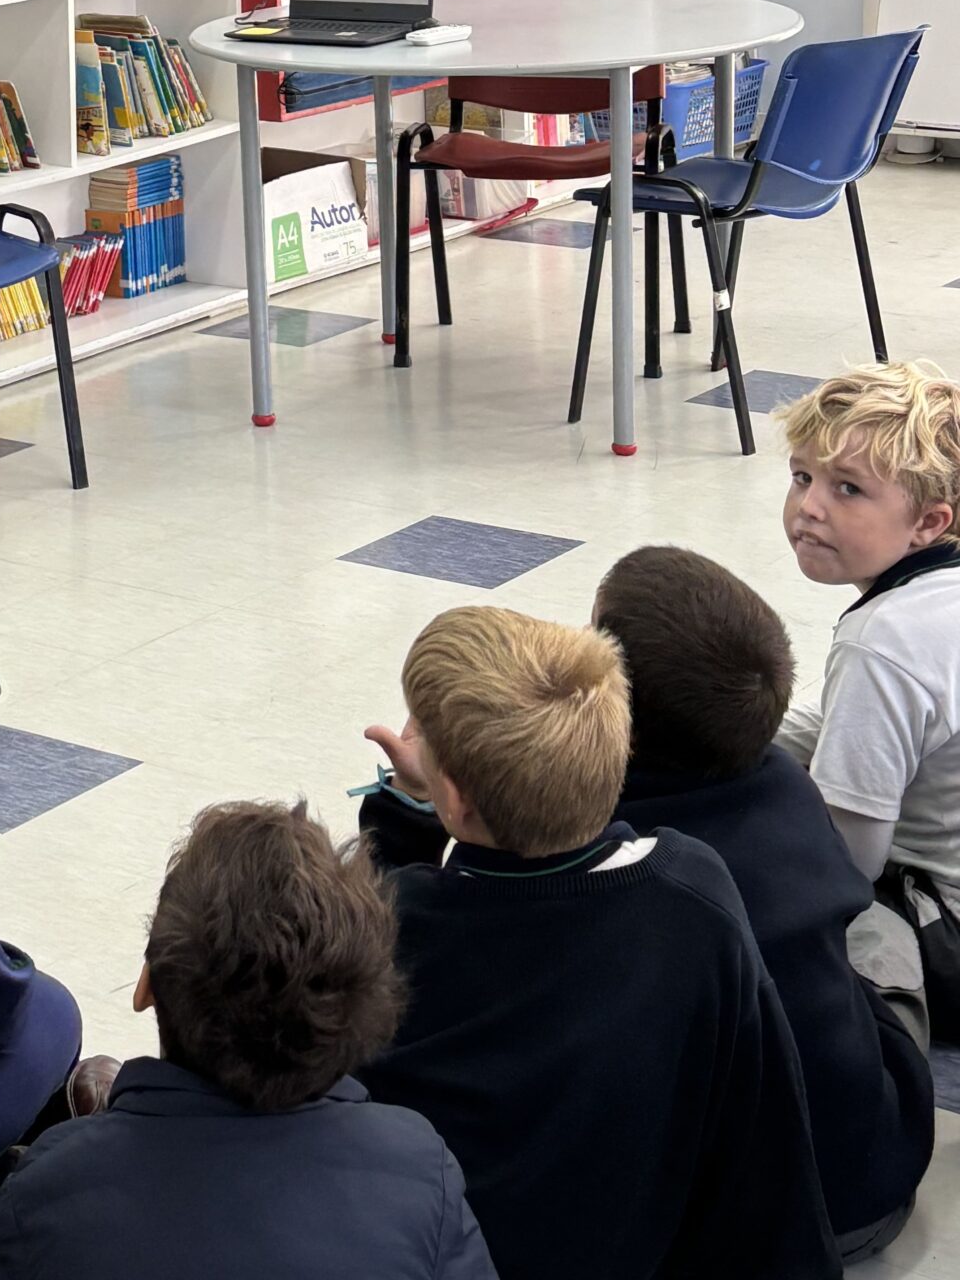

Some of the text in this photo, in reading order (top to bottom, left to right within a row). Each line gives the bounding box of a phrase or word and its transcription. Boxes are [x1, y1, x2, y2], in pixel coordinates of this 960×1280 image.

[310, 202, 356, 233] Autor
[277, 221, 299, 250] A4
[343, 240, 357, 256] 75
